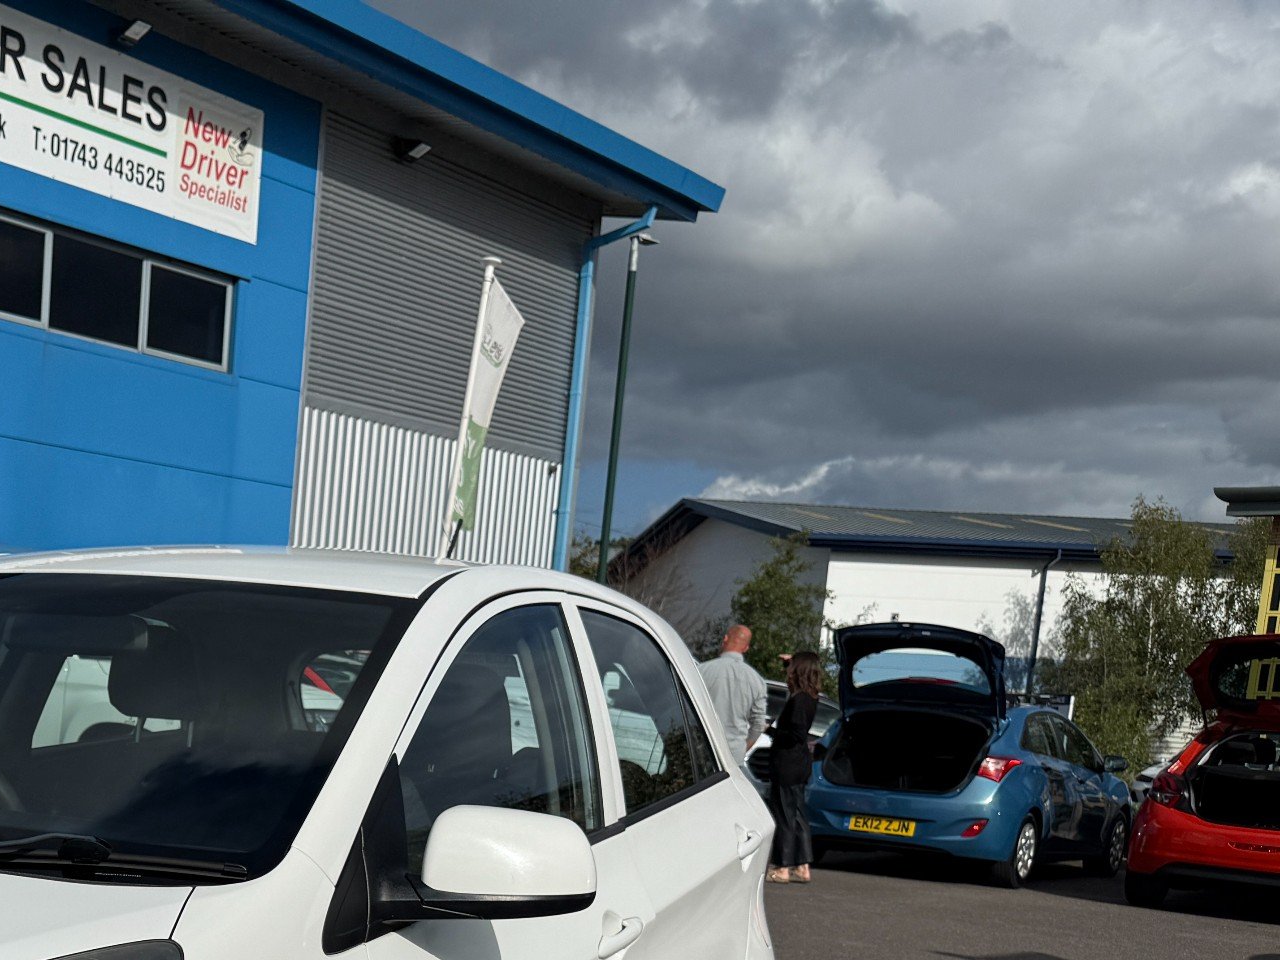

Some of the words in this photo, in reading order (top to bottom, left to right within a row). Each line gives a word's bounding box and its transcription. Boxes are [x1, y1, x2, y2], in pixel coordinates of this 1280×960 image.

[41, 44, 168, 132] SALES
[185, 106, 232, 149] New
[104, 153, 166, 193] 443525
[180, 140, 249, 189] Driver
[179, 174, 248, 212] Specialist
[853, 816, 882, 830] EK12
[884, 820, 910, 833] ZJN
